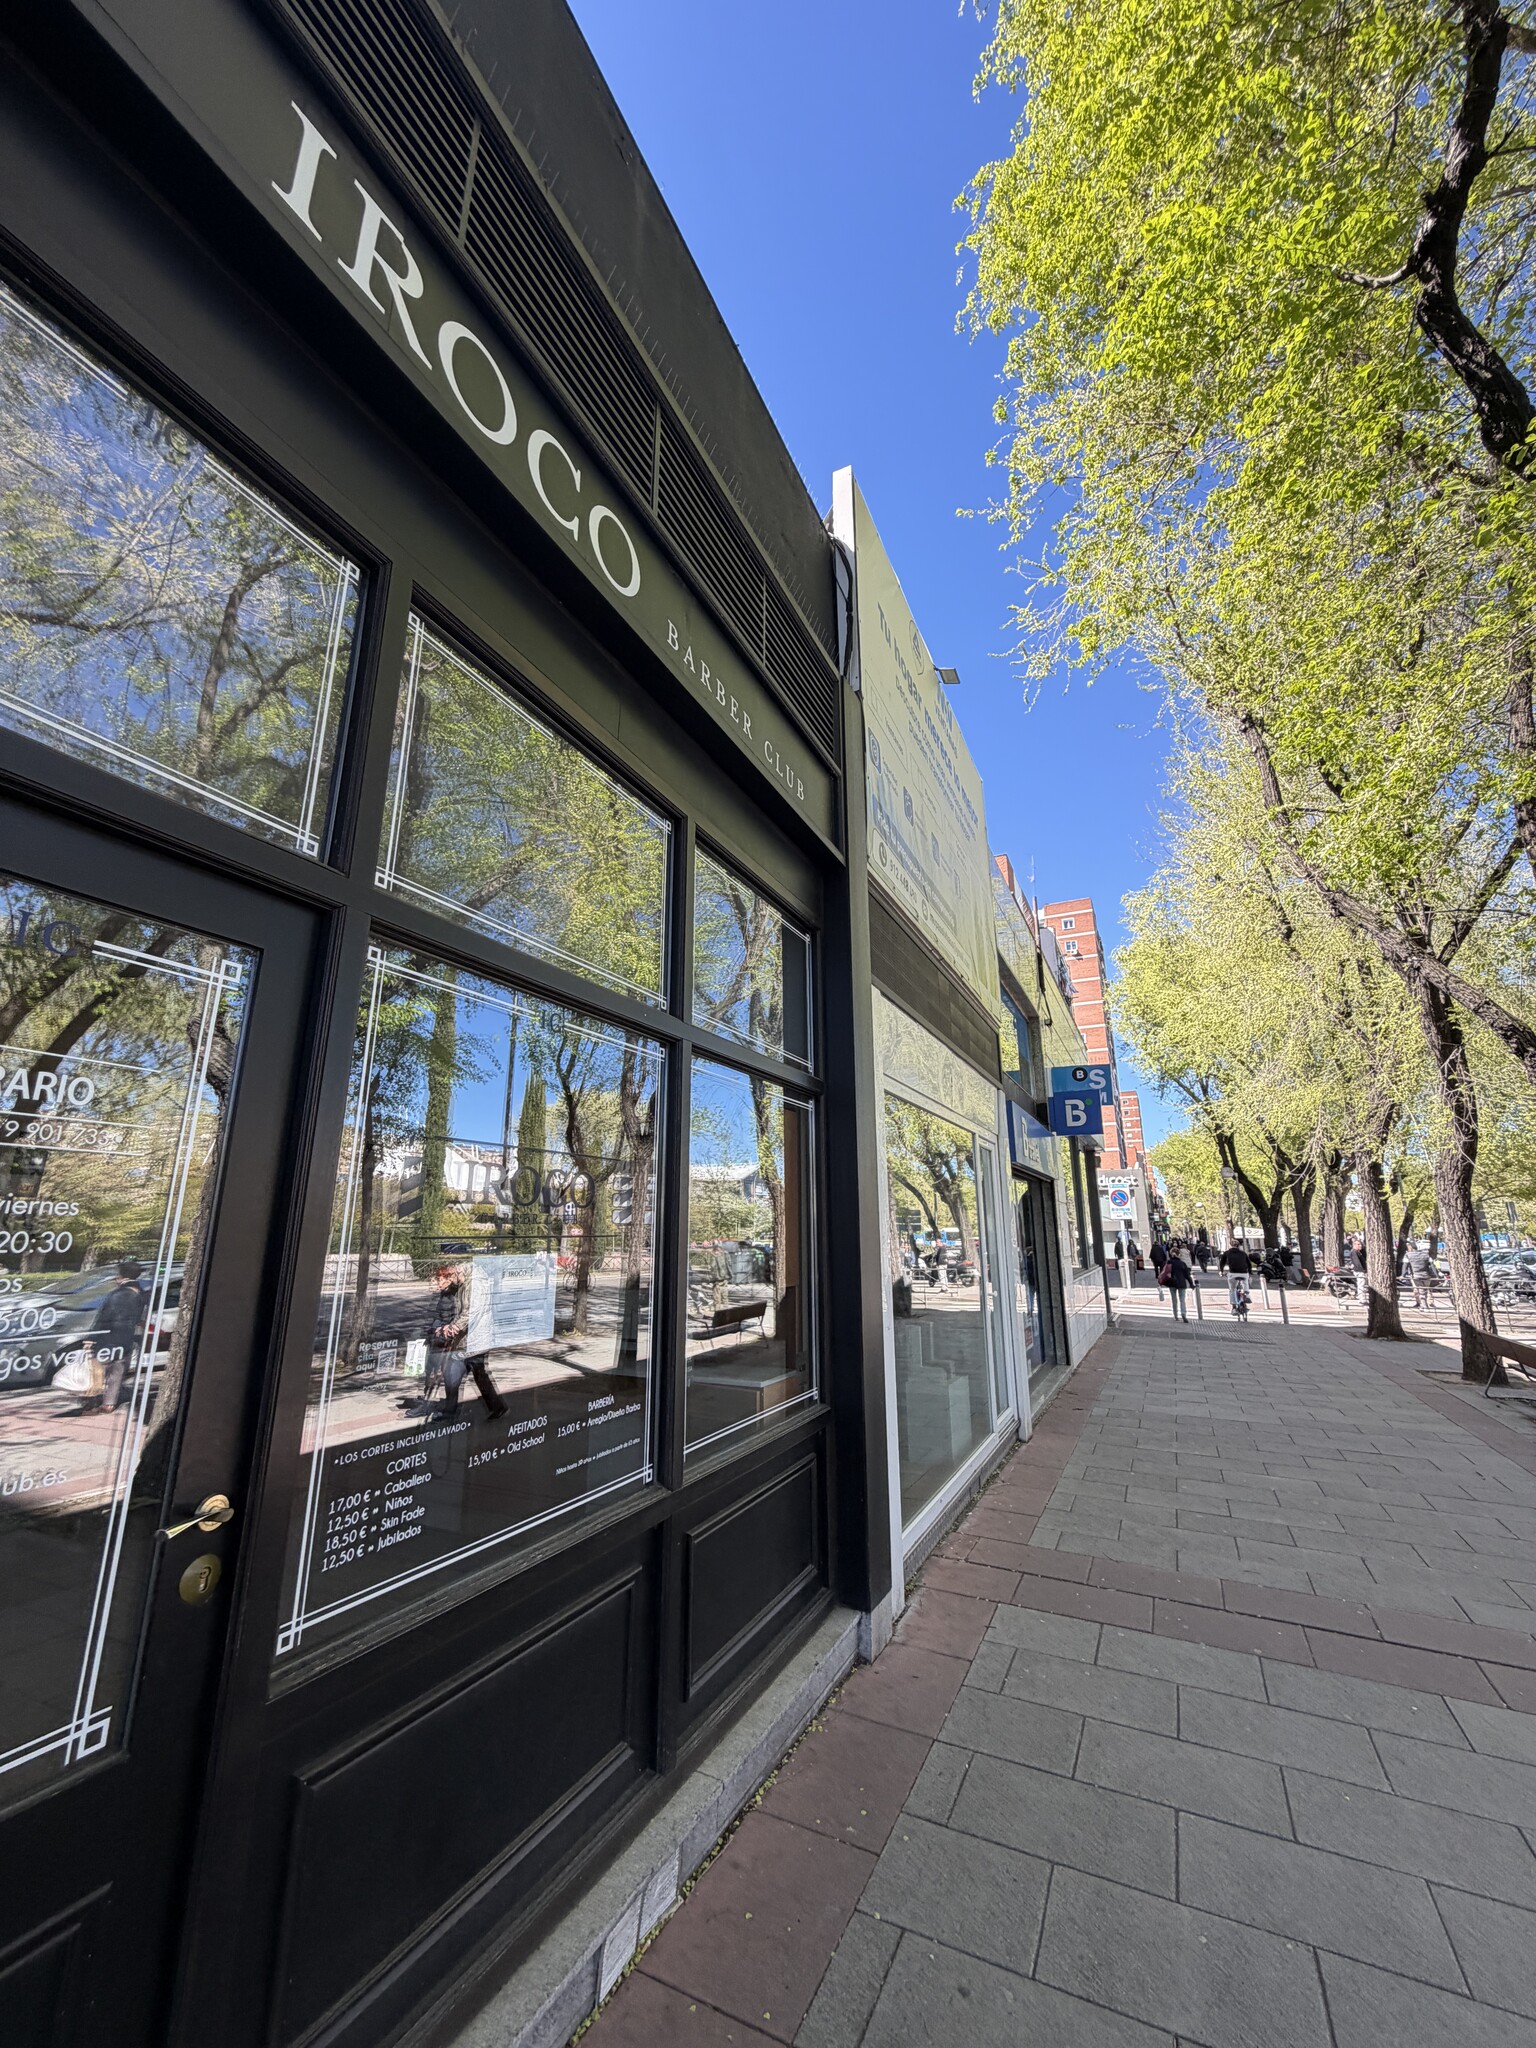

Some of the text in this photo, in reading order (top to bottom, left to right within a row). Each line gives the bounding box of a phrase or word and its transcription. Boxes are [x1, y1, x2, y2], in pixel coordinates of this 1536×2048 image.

[271, 100, 641, 597] IROCO
[877, 599, 891, 651] Tu
[893, 636, 922, 713] hogar
[923, 702, 952, 779] merece
[667, 619, 804, 801] BARBER CLUB
[0, 1064, 95, 1106] ARIO
[1089, 1069, 1106, 1089] S
[1065, 1099, 1087, 1127] B
[26, 1122, 63, 1144] 901
[72, 1127, 111, 1146] 733
[463, 1160, 596, 1208] IROCO
[0, 1231, 73, 1254] 20:30
[97, 1346, 124, 1363] en
[359, 1339, 399, 1352] Reserva
[355, 1360, 376, 1374] aquí
[357, 1353, 374, 1362] cita
[587, 1393, 615, 1412] BARBERÍA
[625, 1403, 641, 1414] Barba
[508, 1415, 548, 1437] AFEITADOS
[339, 1421, 467, 1465] LOS CORTES INCLUYEN LAVADO
[507, 1439, 521, 1454] Old
[522, 1432, 545, 1449] School
[386, 1451, 427, 1475] CORTES
[0, 1470, 67, 1496] ub.es
[384, 1472, 432, 1495] Caballero
[385, 1494, 413, 1513] Niños
[380, 1516, 399, 1531] Skin
[400, 1505, 425, 1524] Fade
[377, 1524, 422, 1552] Jubilados
